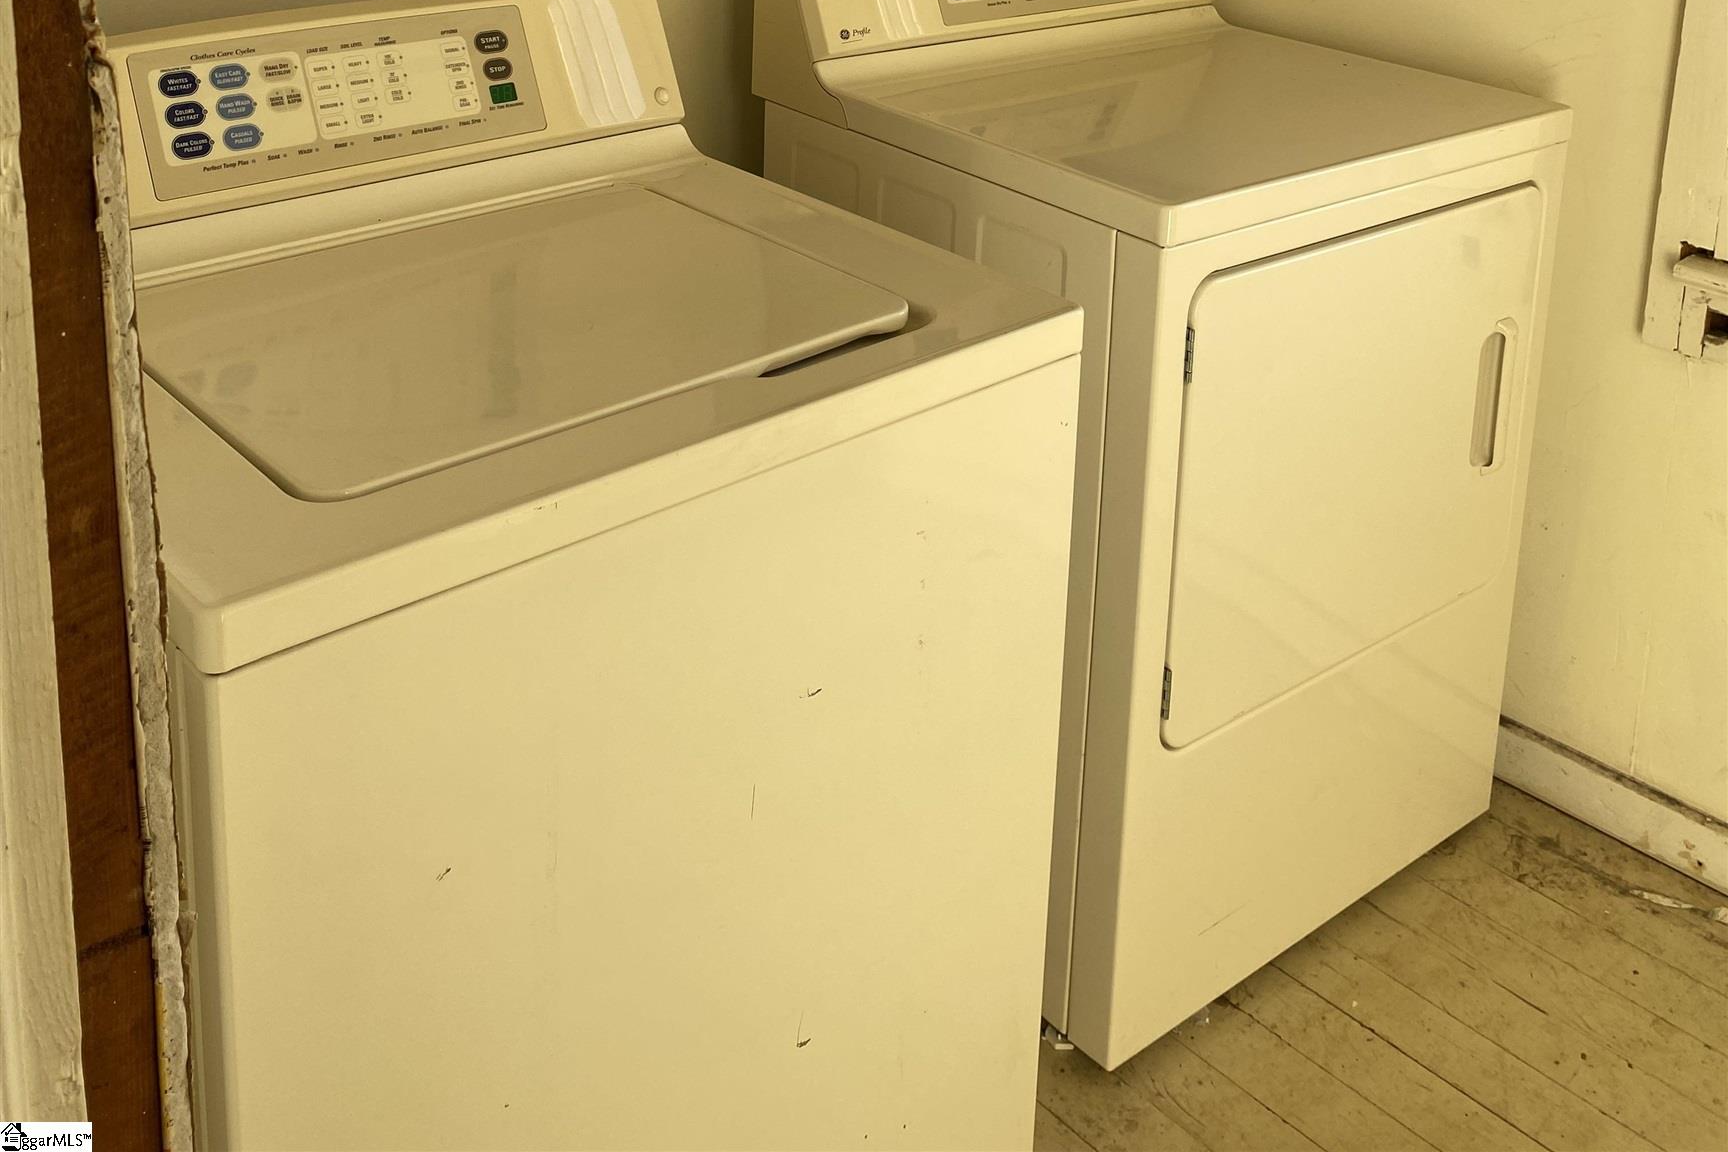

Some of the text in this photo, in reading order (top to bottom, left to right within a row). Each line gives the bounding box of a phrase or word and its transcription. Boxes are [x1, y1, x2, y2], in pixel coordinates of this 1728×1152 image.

[480, 36, 500, 44] START
[190, 48, 256, 61] Clothes Care Cycles
[489, 65, 506, 73] STOP
